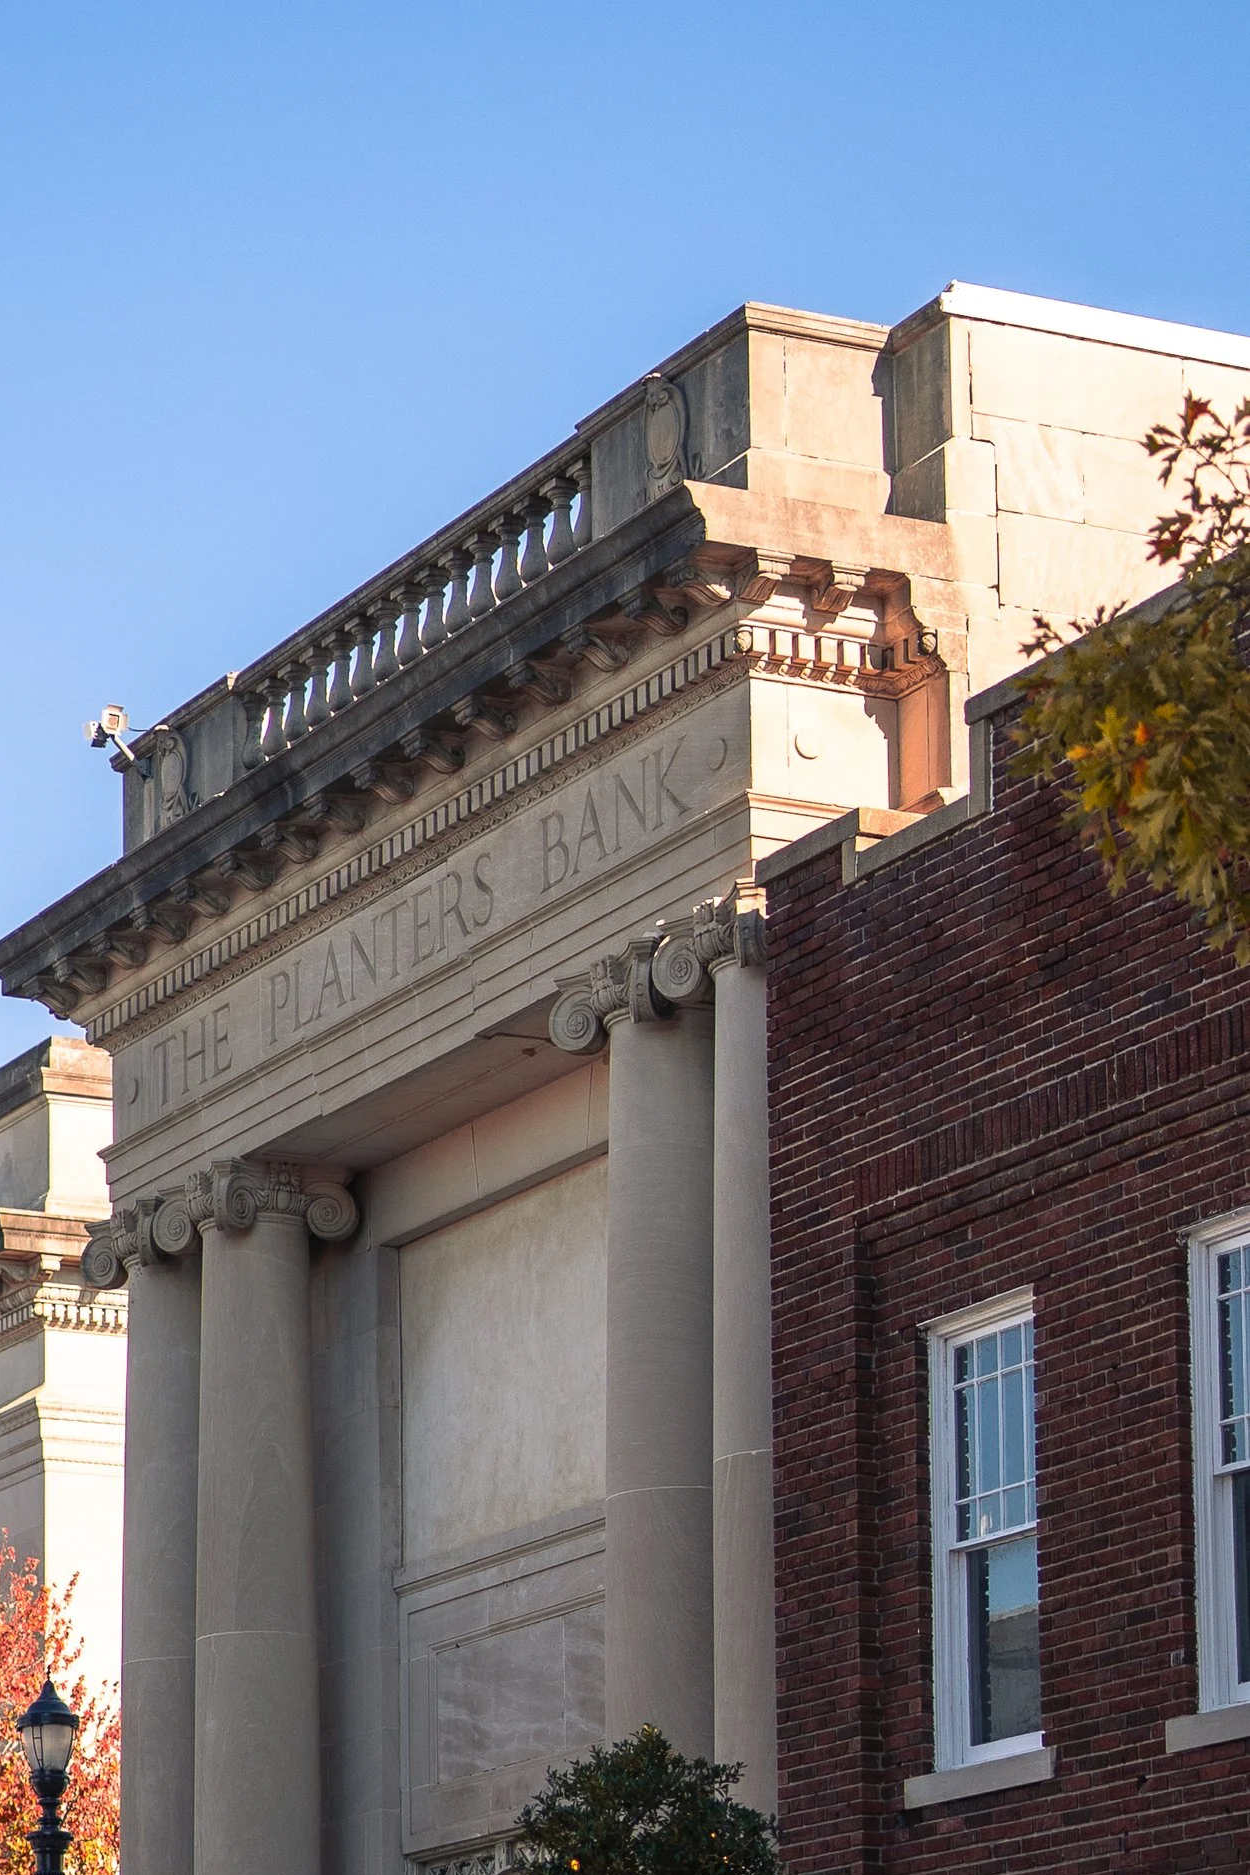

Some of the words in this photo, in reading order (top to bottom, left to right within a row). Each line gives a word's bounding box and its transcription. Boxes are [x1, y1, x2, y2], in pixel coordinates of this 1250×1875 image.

[153, 1004, 232, 1107] THE
[266, 851, 497, 1047] PLANTERS
[541, 734, 692, 895] BANK
